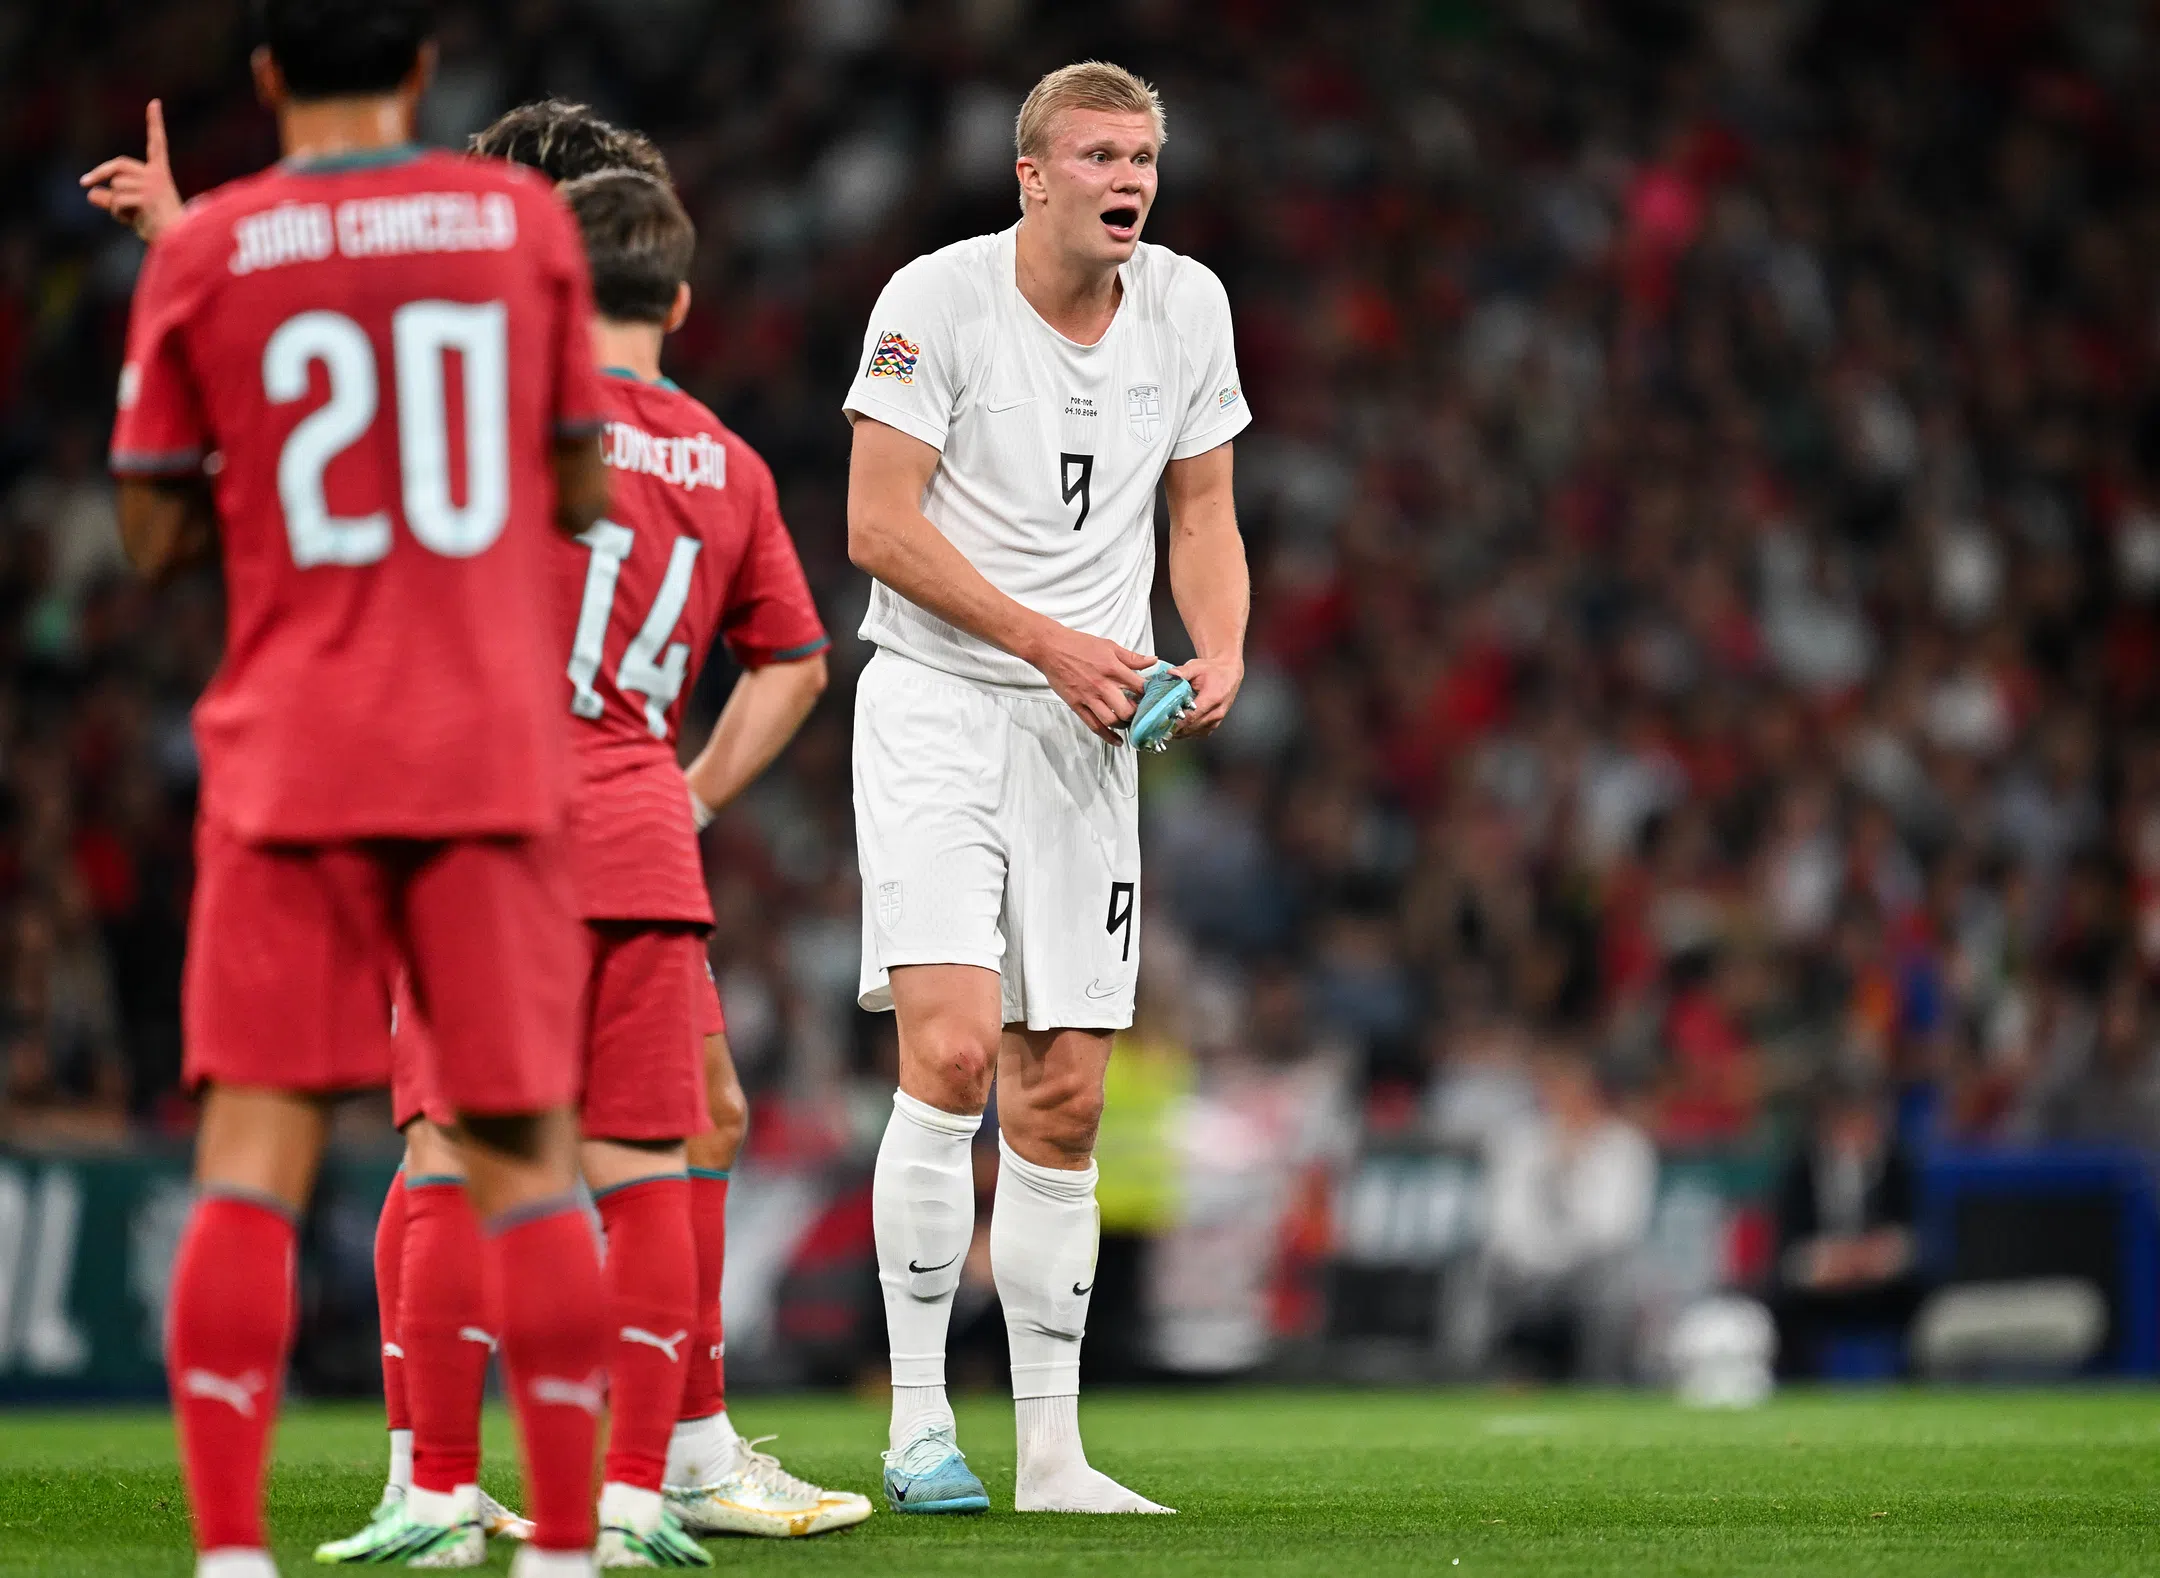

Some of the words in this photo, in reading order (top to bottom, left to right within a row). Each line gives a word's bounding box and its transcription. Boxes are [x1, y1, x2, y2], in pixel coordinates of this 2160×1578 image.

[229, 199, 334, 275] JOÃO
[336, 192, 517, 258] CANCELO
[262, 299, 509, 569] 20
[1060, 452, 1094, 532] 9
[567, 518, 704, 740] 14
[1106, 881, 1134, 962] 9
